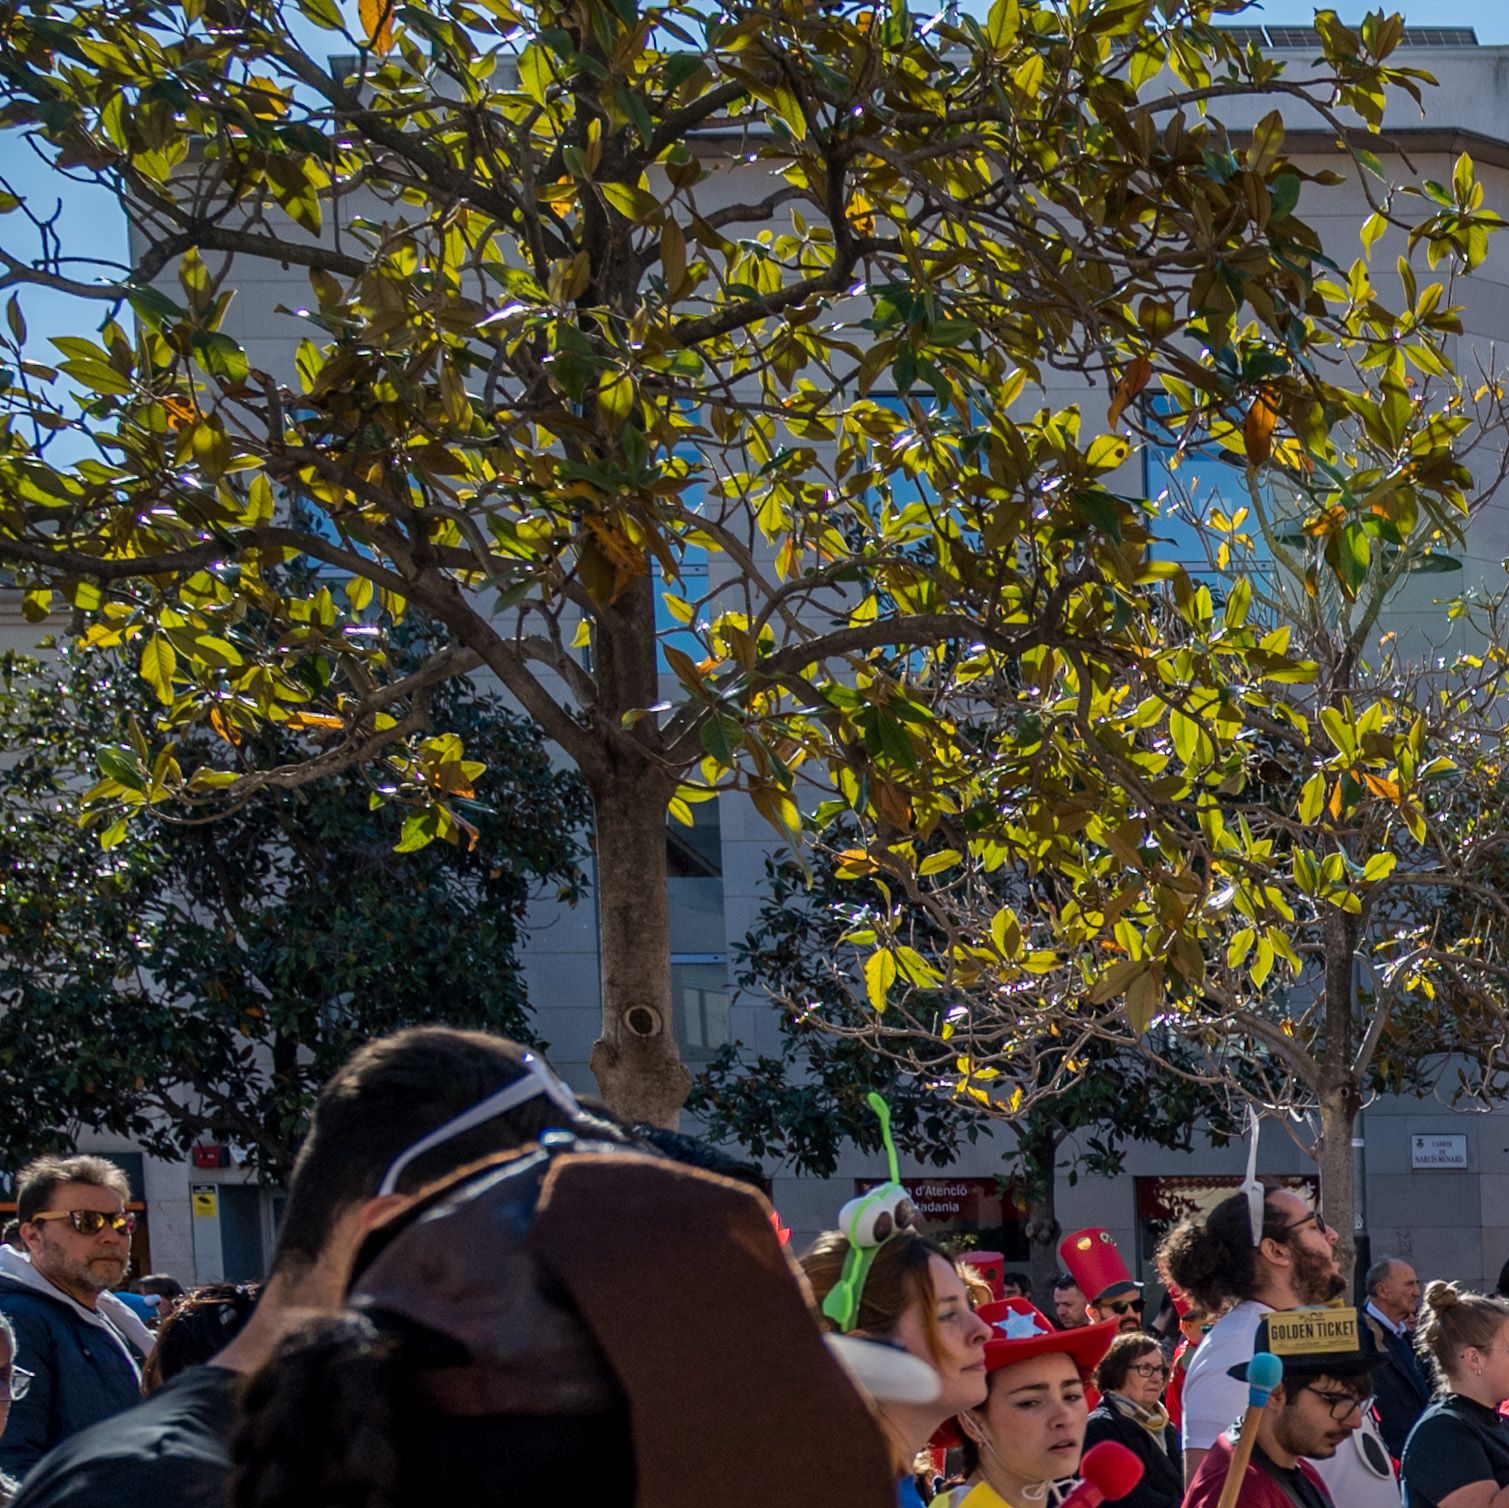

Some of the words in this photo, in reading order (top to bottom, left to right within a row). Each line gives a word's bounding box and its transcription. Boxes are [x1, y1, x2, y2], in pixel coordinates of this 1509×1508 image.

[915, 1185, 968, 1197] d'Atenció
[917, 1201, 960, 1213] tadania
[1271, 1323, 1314, 1340] GOLDEN
[1316, 1320, 1355, 1337] TICKET
